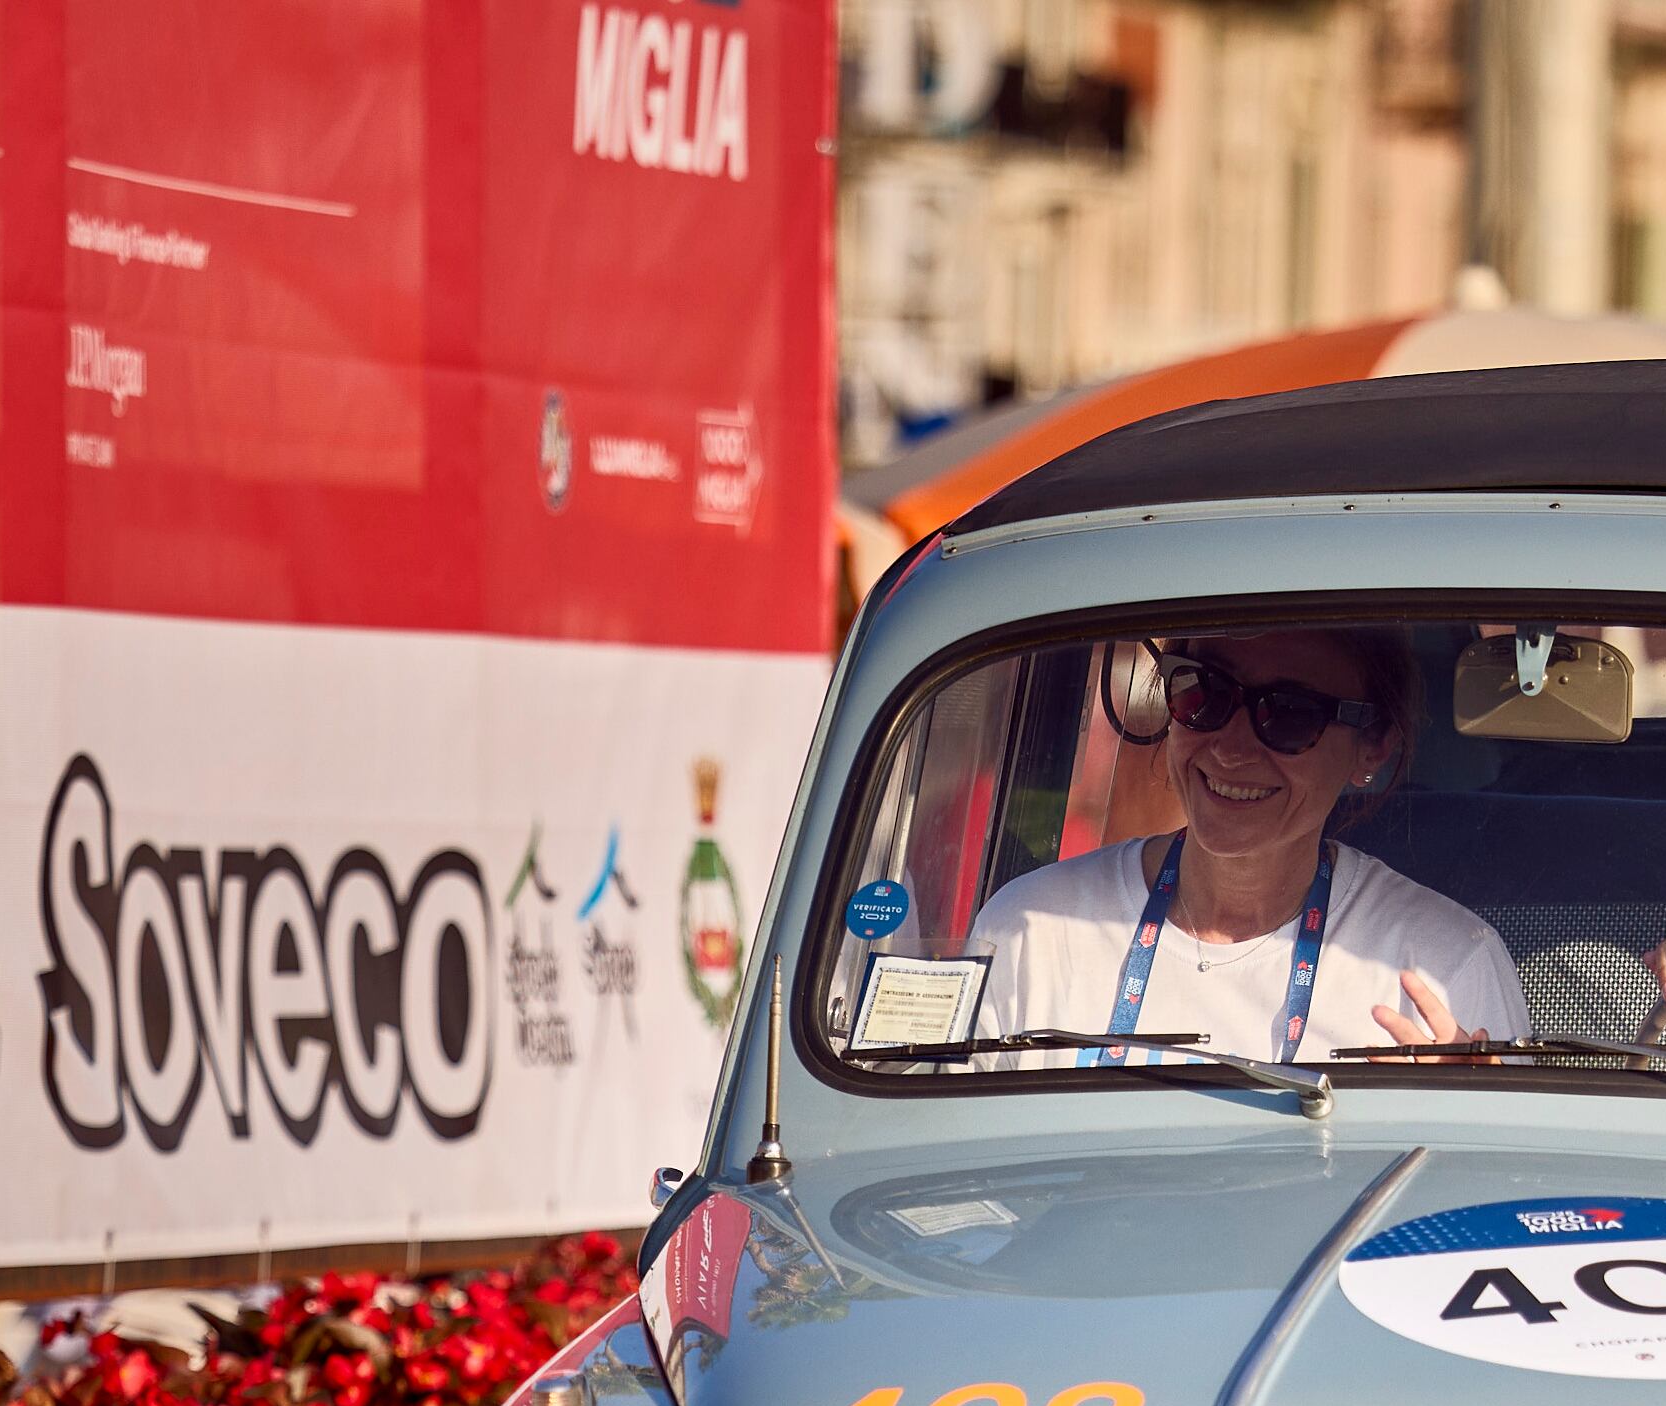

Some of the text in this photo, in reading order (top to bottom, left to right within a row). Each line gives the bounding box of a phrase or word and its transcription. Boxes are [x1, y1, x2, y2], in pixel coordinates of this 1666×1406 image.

[573, 3, 747, 181] MIGLIA
[854, 904, 903, 913] VERIFICATO
[37, 752, 494, 1155] Soveco
[1305, 964, 1313, 986] MIGLIA
[1123, 976, 1134, 999] MIGLIA
[1521, 1215, 1585, 1227] 1000
[1529, 1220, 1623, 1234] MIGLIA
